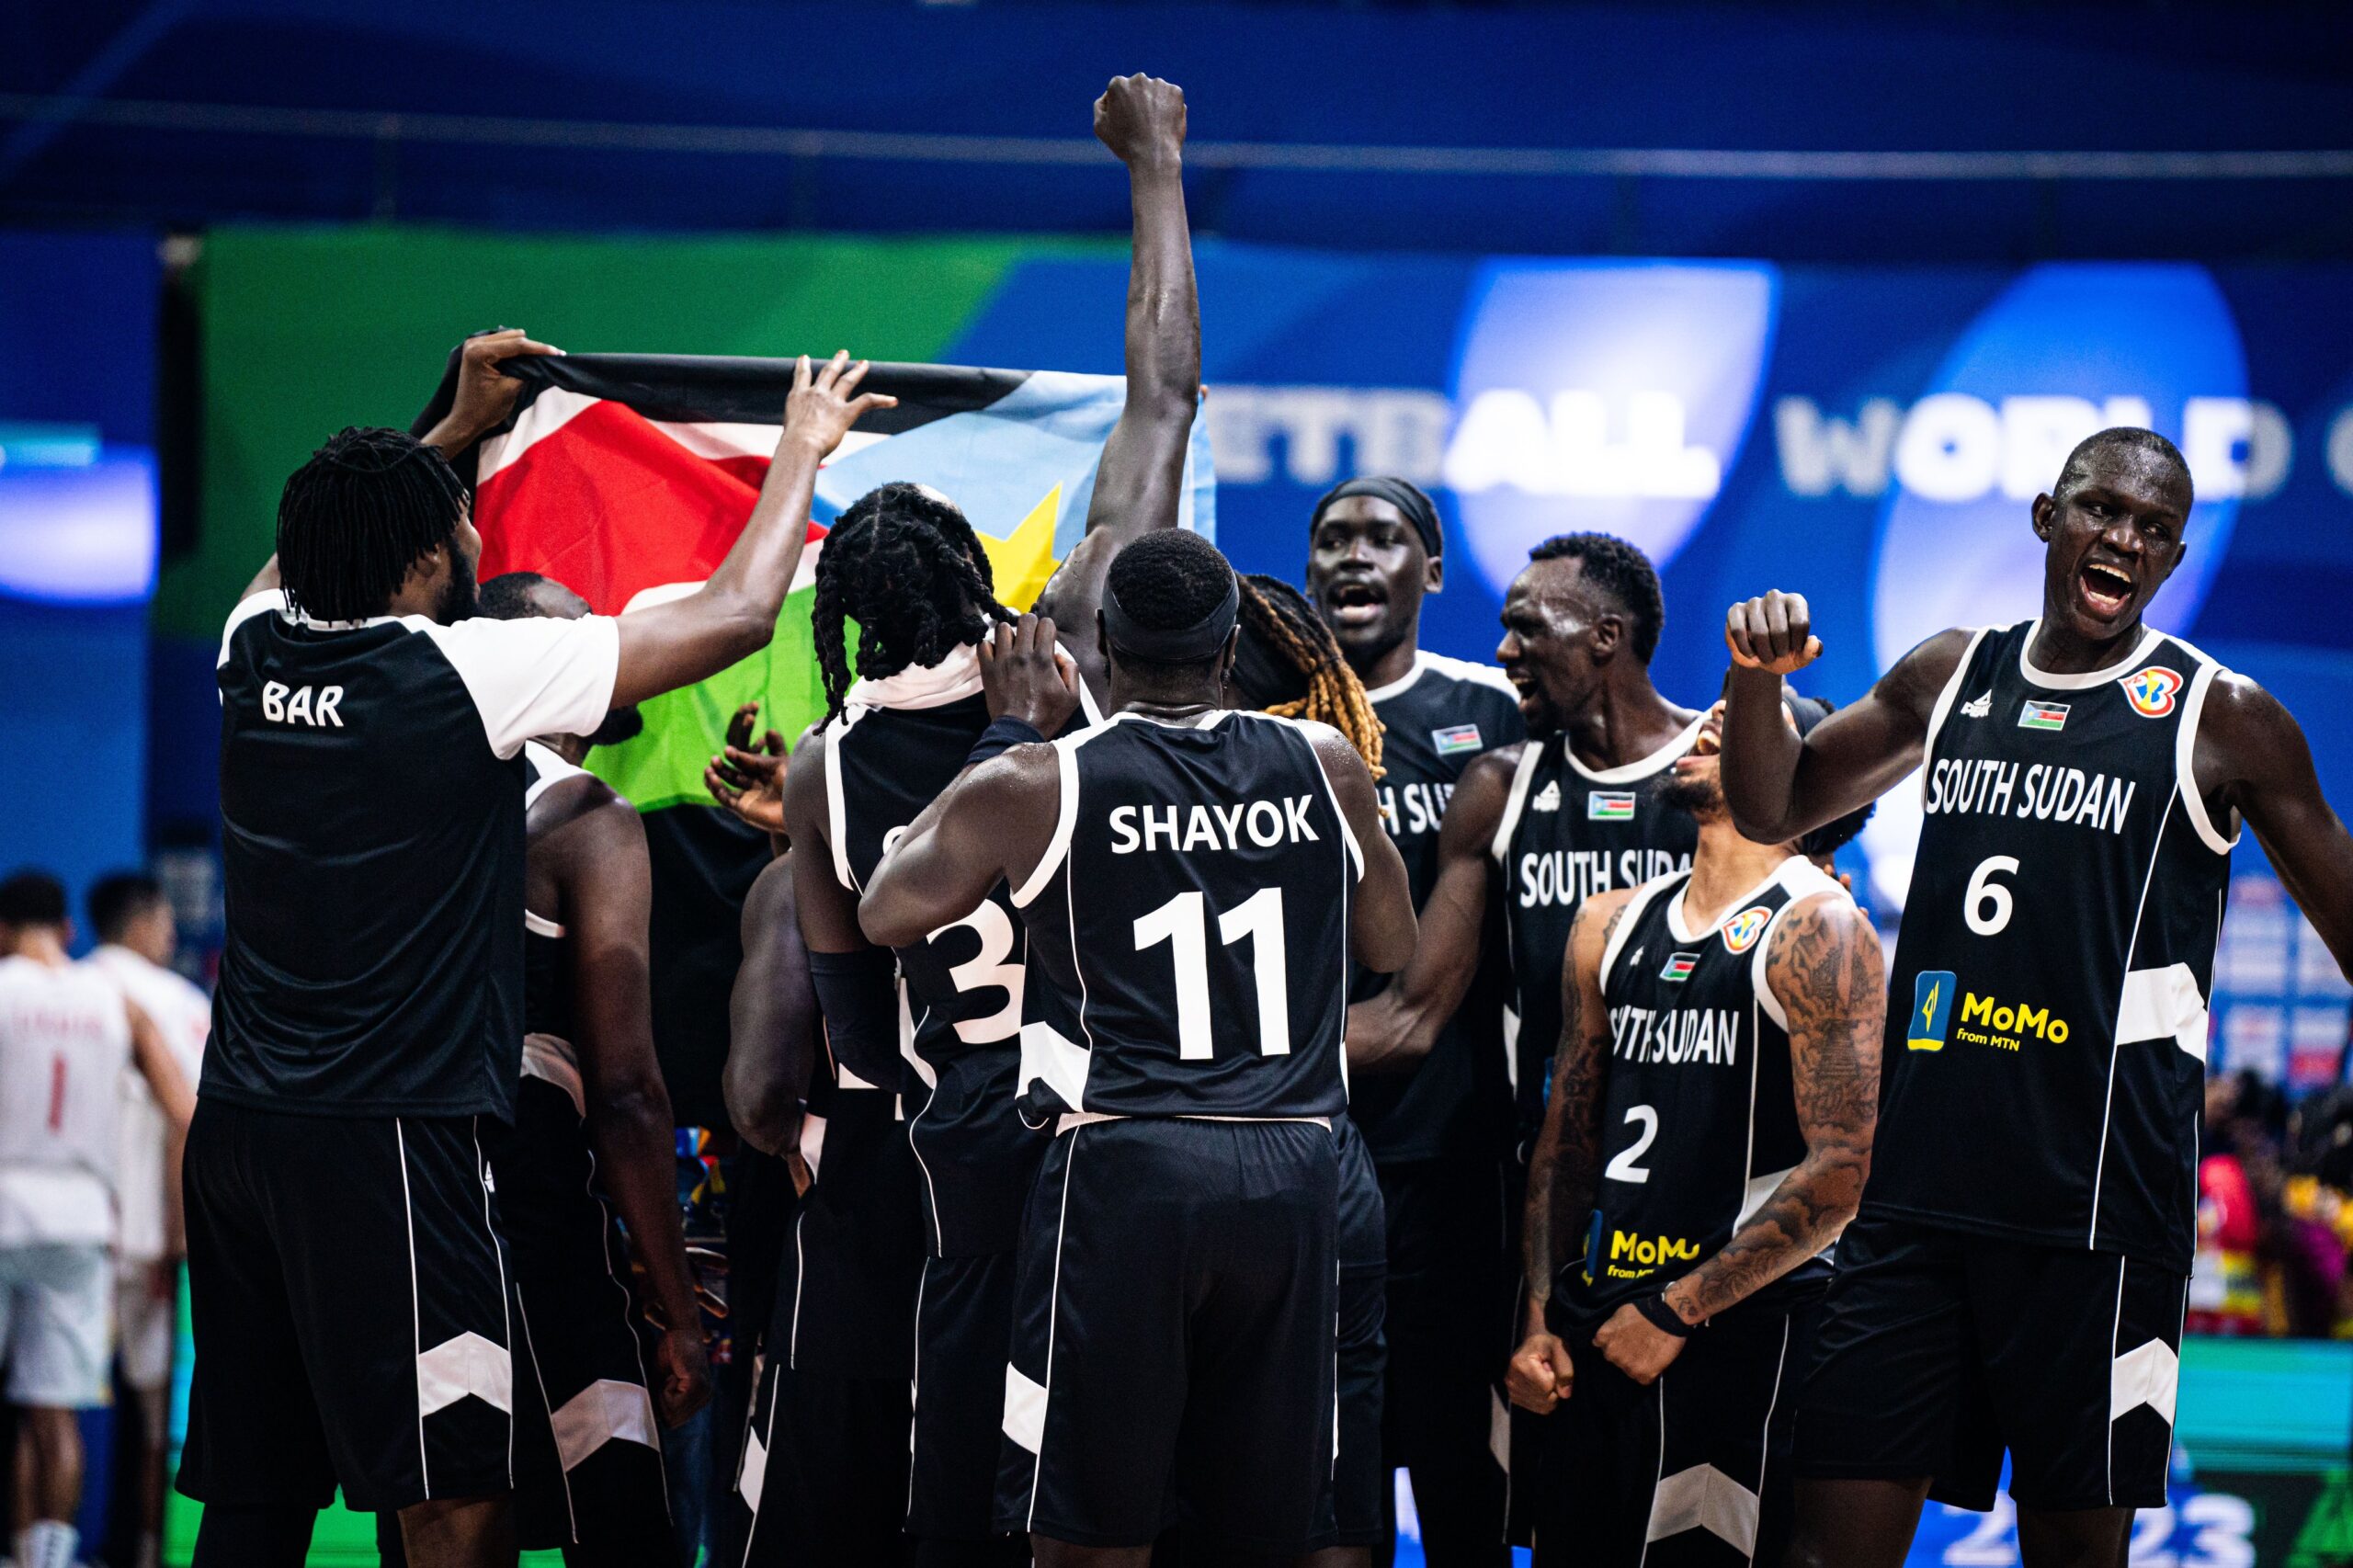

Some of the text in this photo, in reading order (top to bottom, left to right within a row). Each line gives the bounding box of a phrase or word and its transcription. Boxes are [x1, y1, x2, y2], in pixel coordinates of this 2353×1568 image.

[263, 680, 344, 727] BAR
[1108, 794, 1320, 855] SHAYOK
[1404, 783, 1455, 834] SU
[1927, 758, 2136, 835] SOUTH SUDAN
[1520, 850, 1611, 908] SOUTH
[1964, 855, 2020, 937] 6
[926, 898, 1027, 1045] 3
[1133, 887, 1290, 1060] 11
[1652, 1007, 1740, 1066] SUDAN
[1956, 1028, 2020, 1051] from MTN
[1961, 992, 2069, 1044] MoMo
[49, 1052, 67, 1135] 1
[1605, 1105, 1658, 1184] 2
[1608, 1265, 1636, 1278] from
[1941, 1489, 2256, 1568] 223
